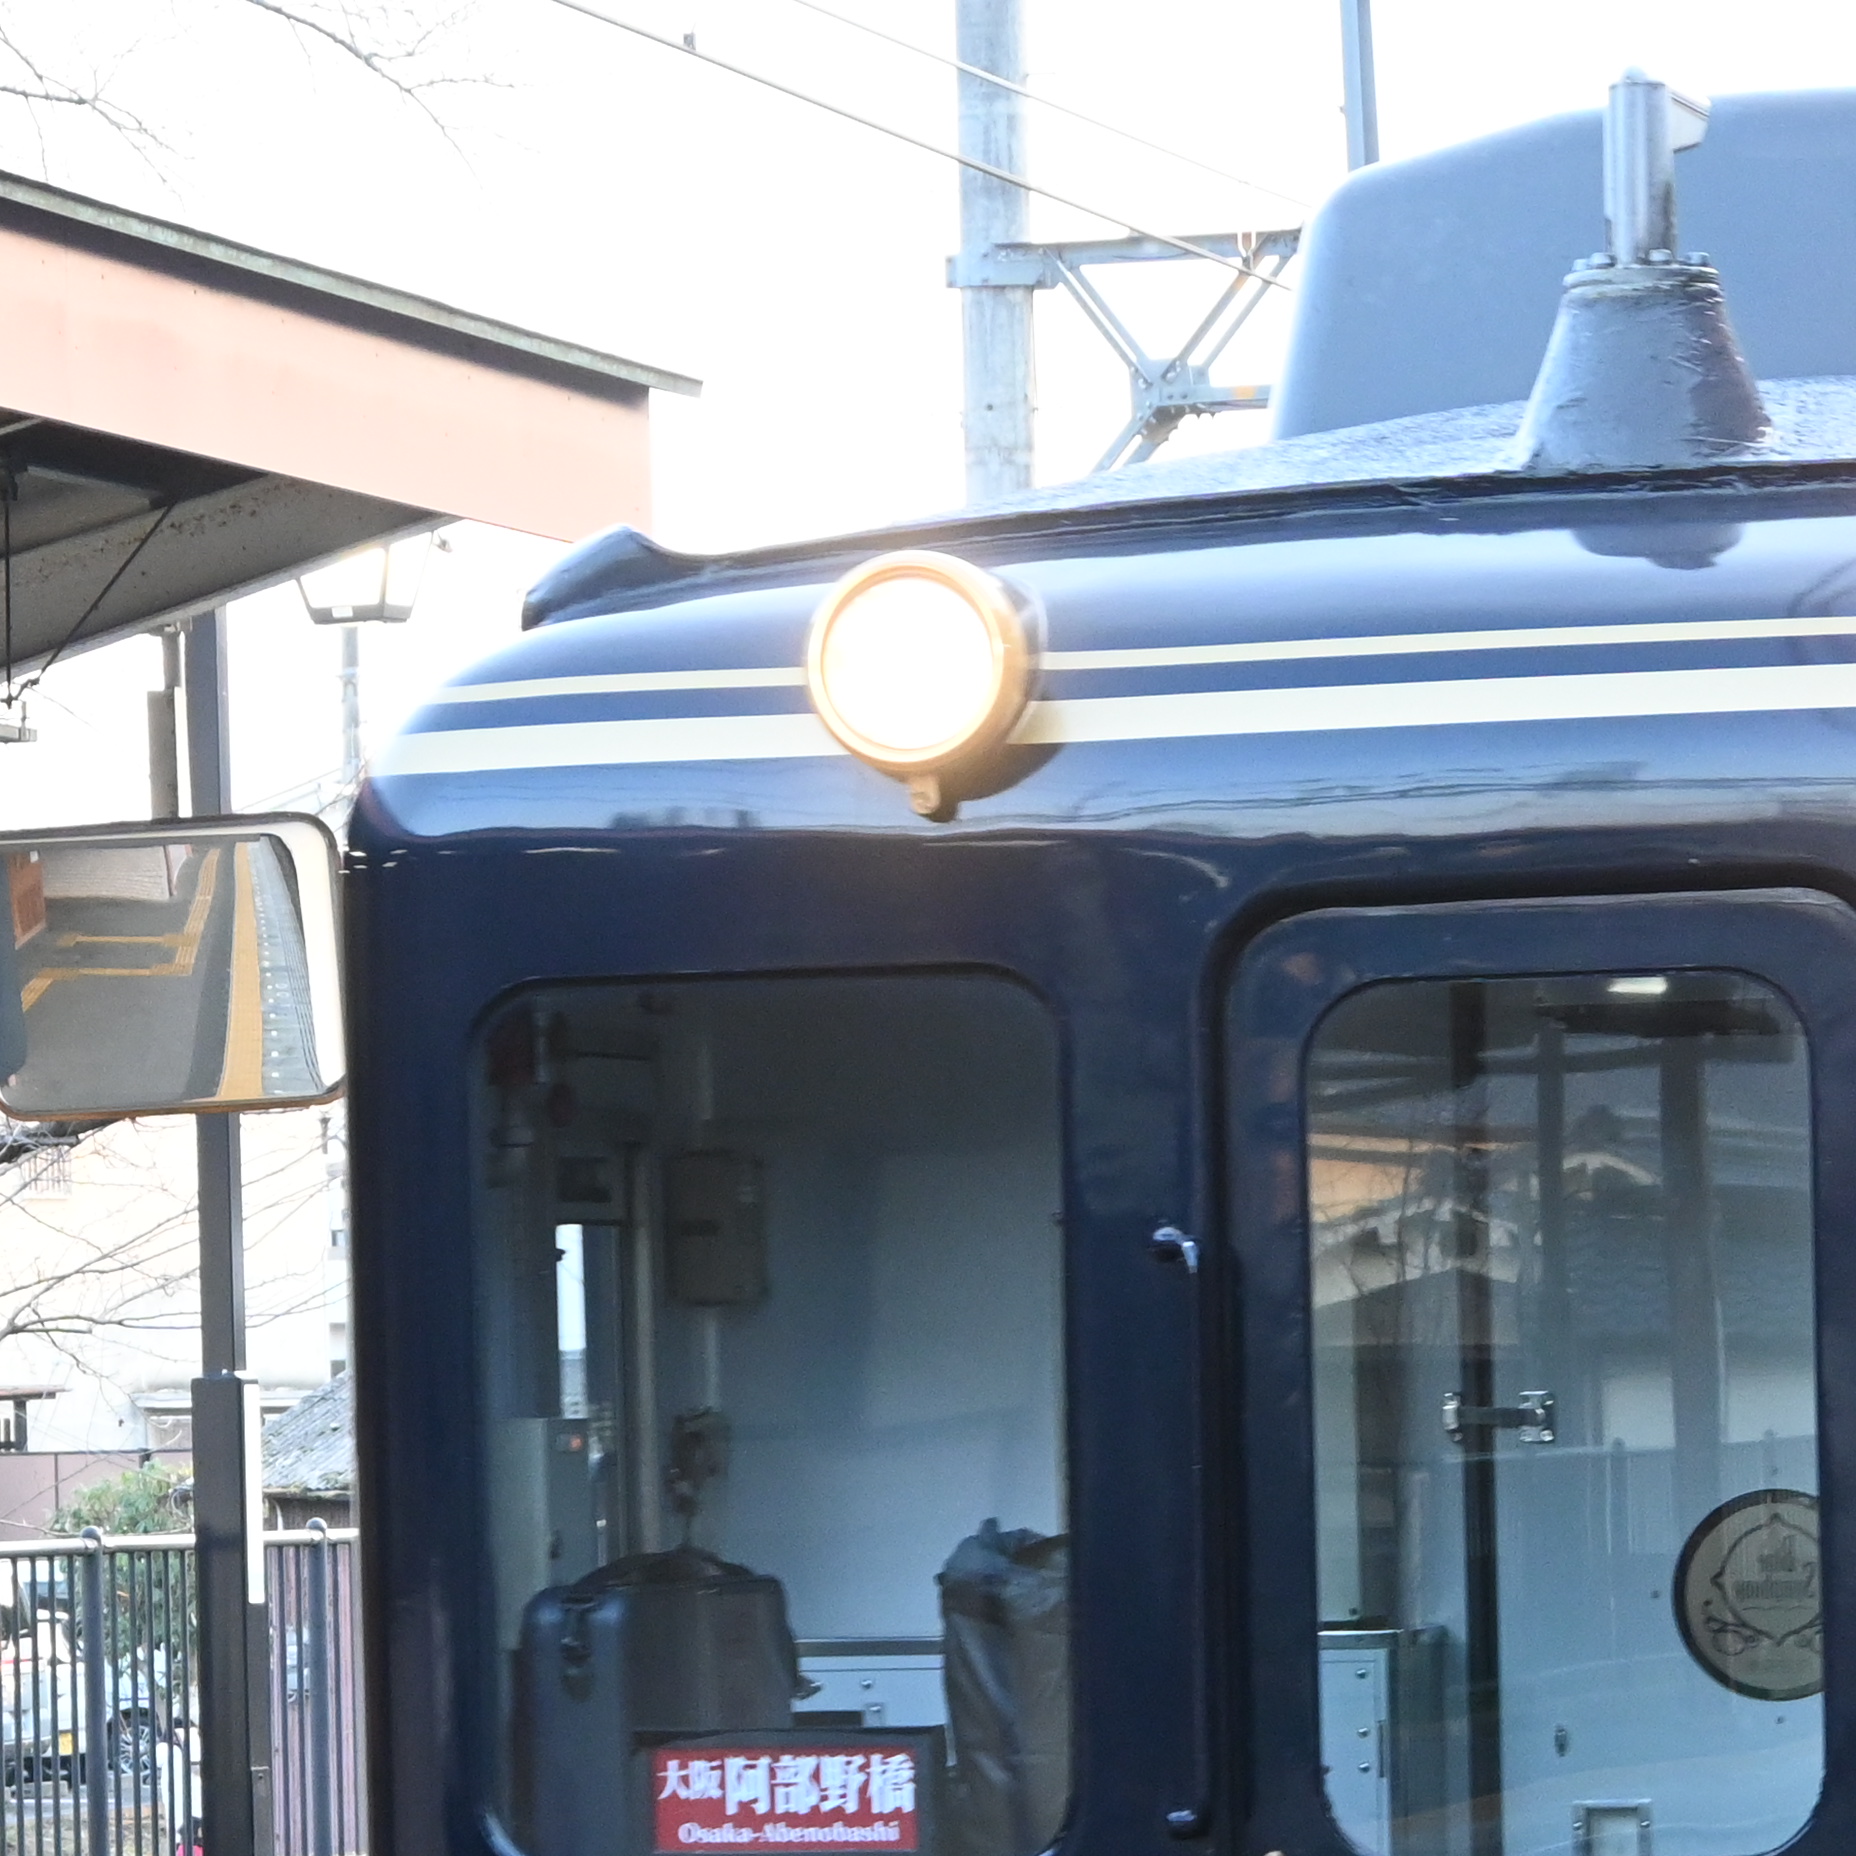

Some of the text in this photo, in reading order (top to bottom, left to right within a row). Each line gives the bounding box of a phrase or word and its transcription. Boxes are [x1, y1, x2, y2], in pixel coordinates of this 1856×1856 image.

[657, 1753, 916, 1816] 大阪阿部野橋
[678, 1821, 900, 1844] Osaka-Abenobashi
